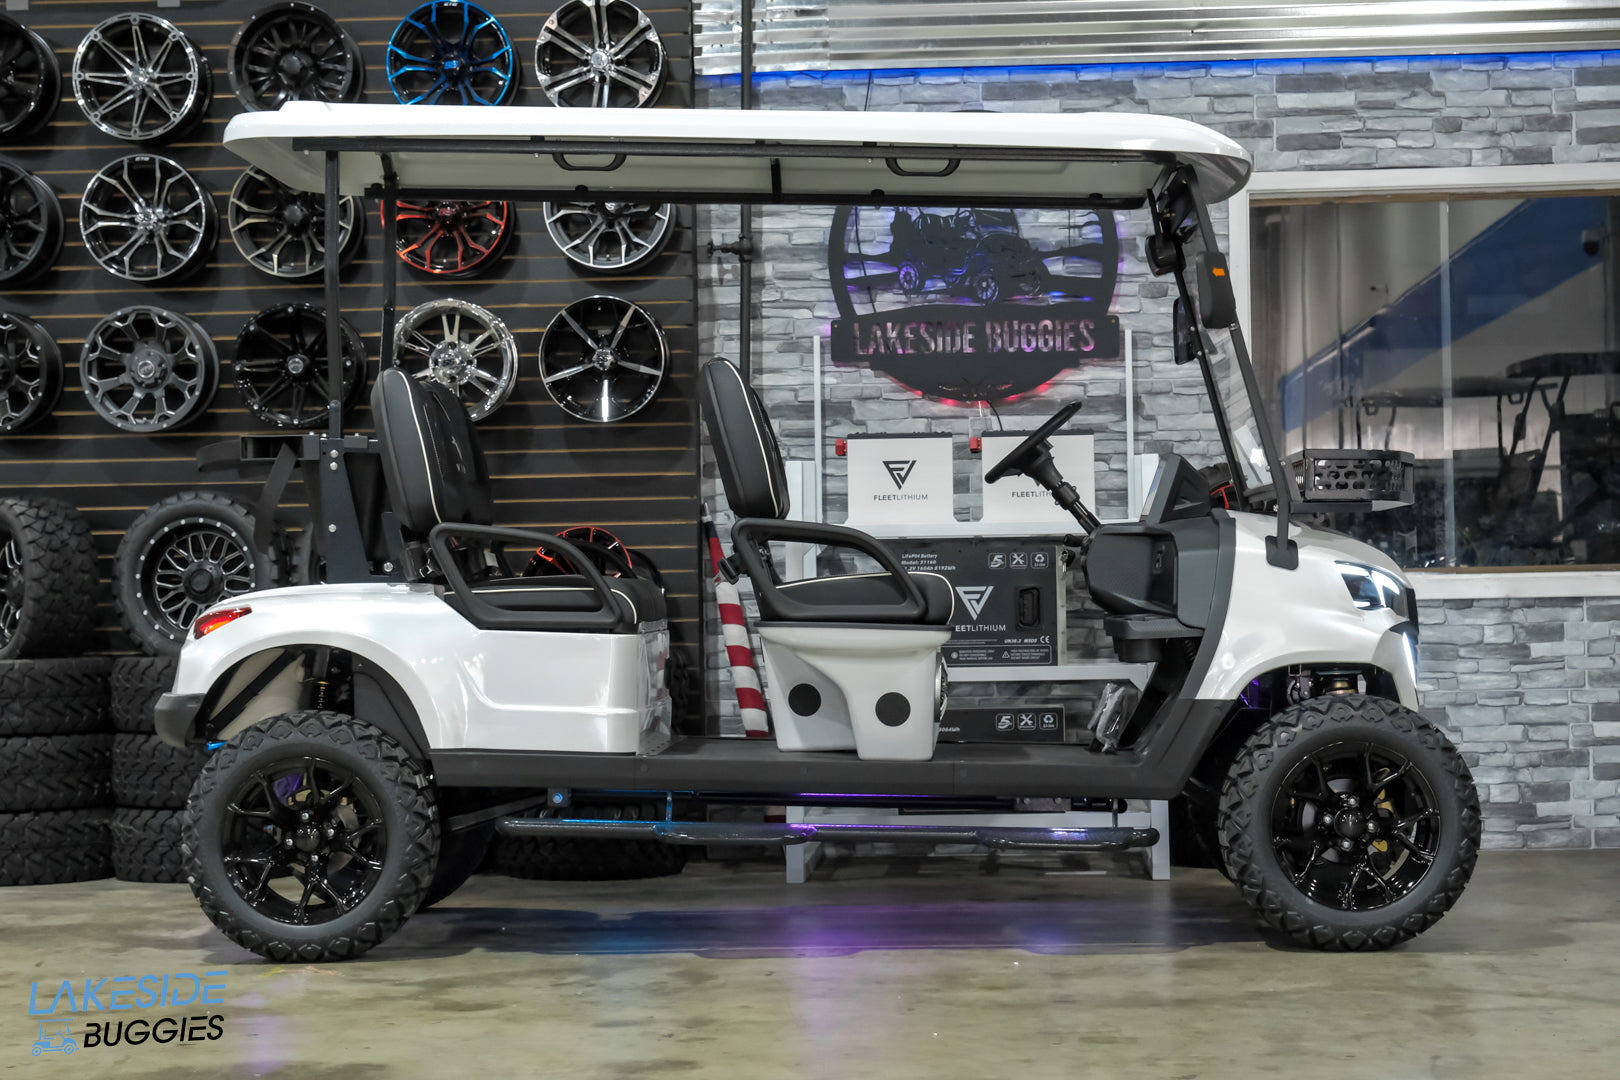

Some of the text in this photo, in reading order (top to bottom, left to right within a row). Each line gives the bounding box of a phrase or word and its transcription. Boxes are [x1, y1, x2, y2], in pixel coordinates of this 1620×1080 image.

[853, 319, 1096, 355] LAKESIDE BUGGIES
[873, 493, 928, 501] FLEETLITHIUM
[1011, 490, 1053, 498] FLEETLITH
[955, 624, 1006, 632] EETLITHIUM
